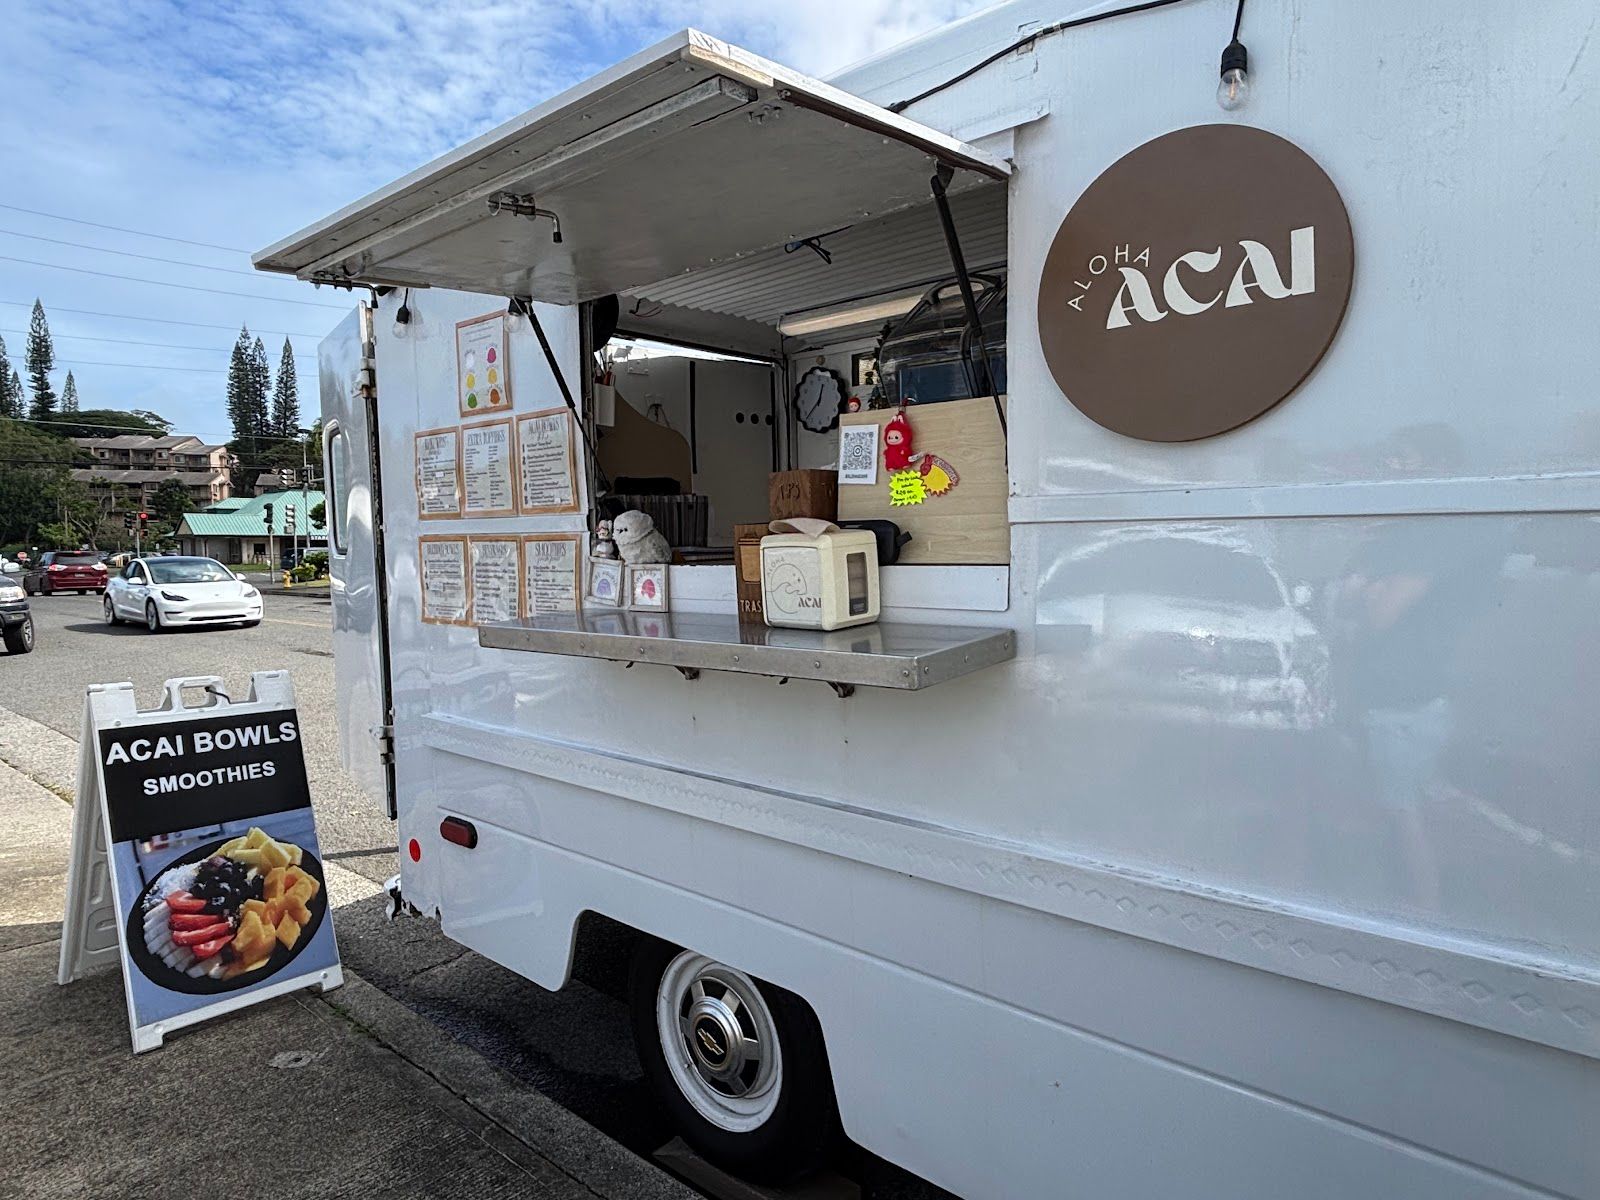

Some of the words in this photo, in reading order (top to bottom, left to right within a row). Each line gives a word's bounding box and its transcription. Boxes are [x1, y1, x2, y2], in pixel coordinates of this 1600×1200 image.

[1067, 243, 1151, 311] ALOHA
[1106, 225, 1316, 330] ACAI
[740, 599, 762, 613] TRAS
[798, 597, 822, 608] ACAI
[105, 734, 185, 766] ACAI
[193, 721, 297, 754] BOWLS
[143, 761, 276, 796] SMOOTHIES
